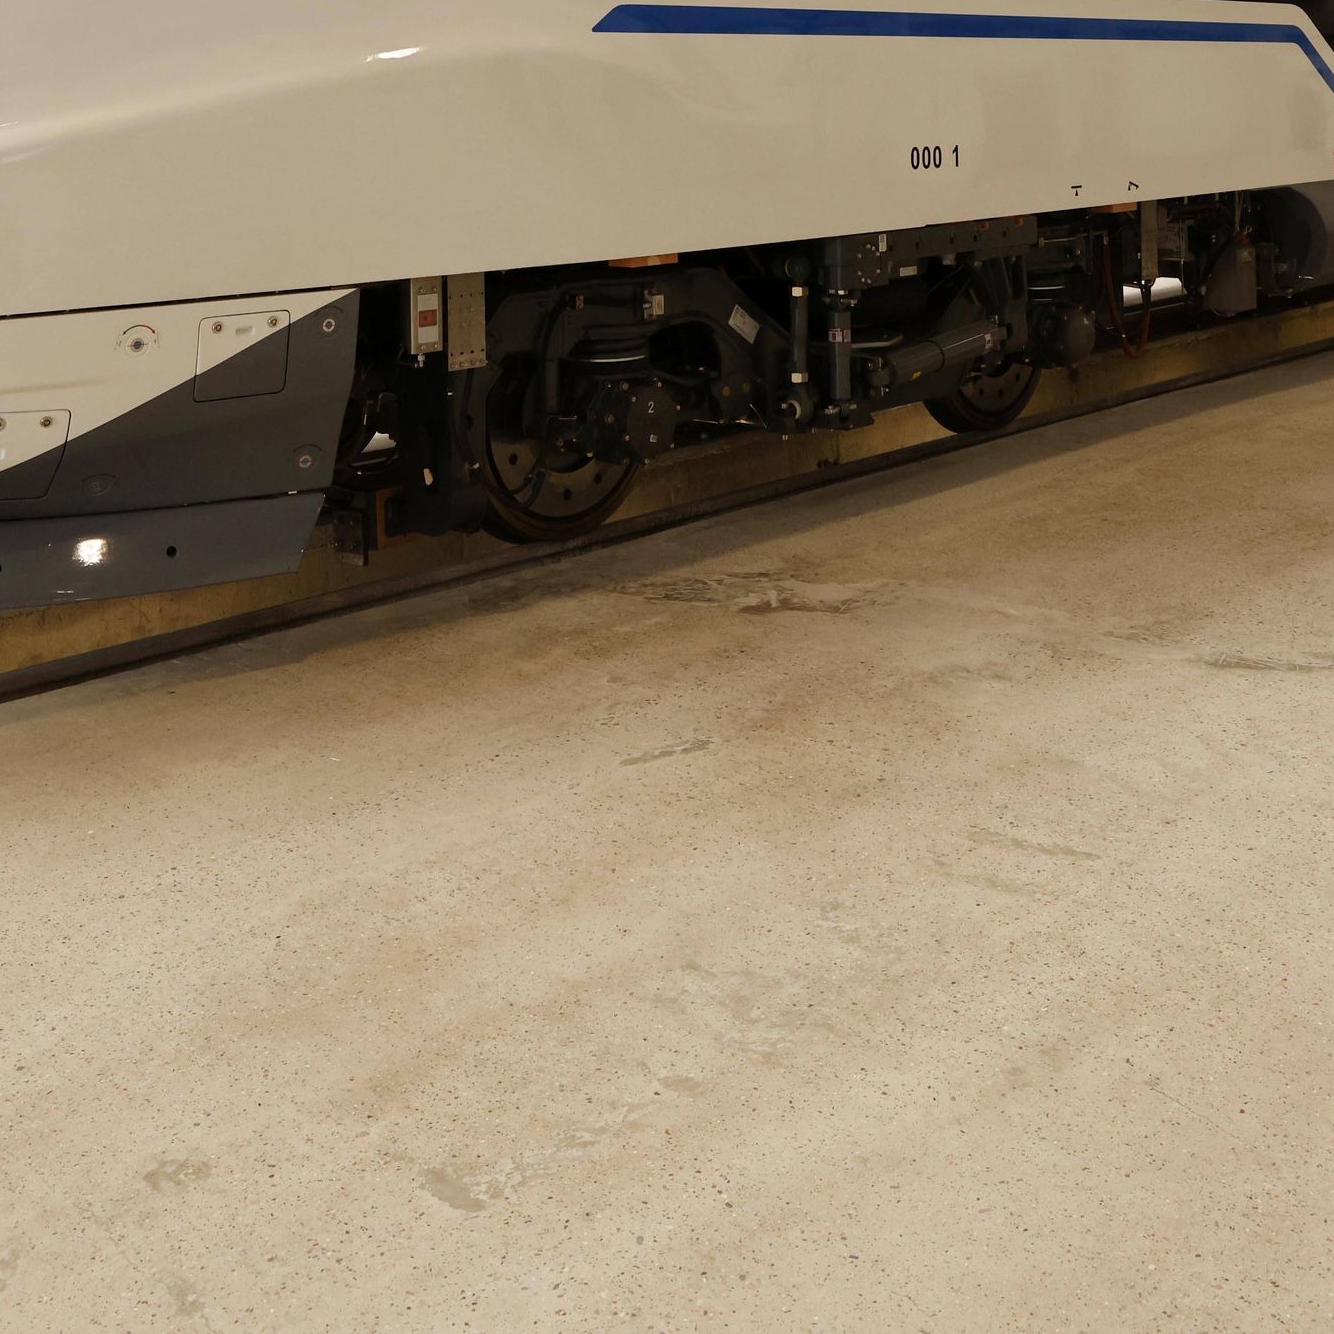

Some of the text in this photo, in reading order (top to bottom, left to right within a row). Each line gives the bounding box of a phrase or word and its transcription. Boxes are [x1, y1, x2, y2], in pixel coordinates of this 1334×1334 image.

[910, 144, 959, 170] 000 1
[647, 401, 655, 414] 2
